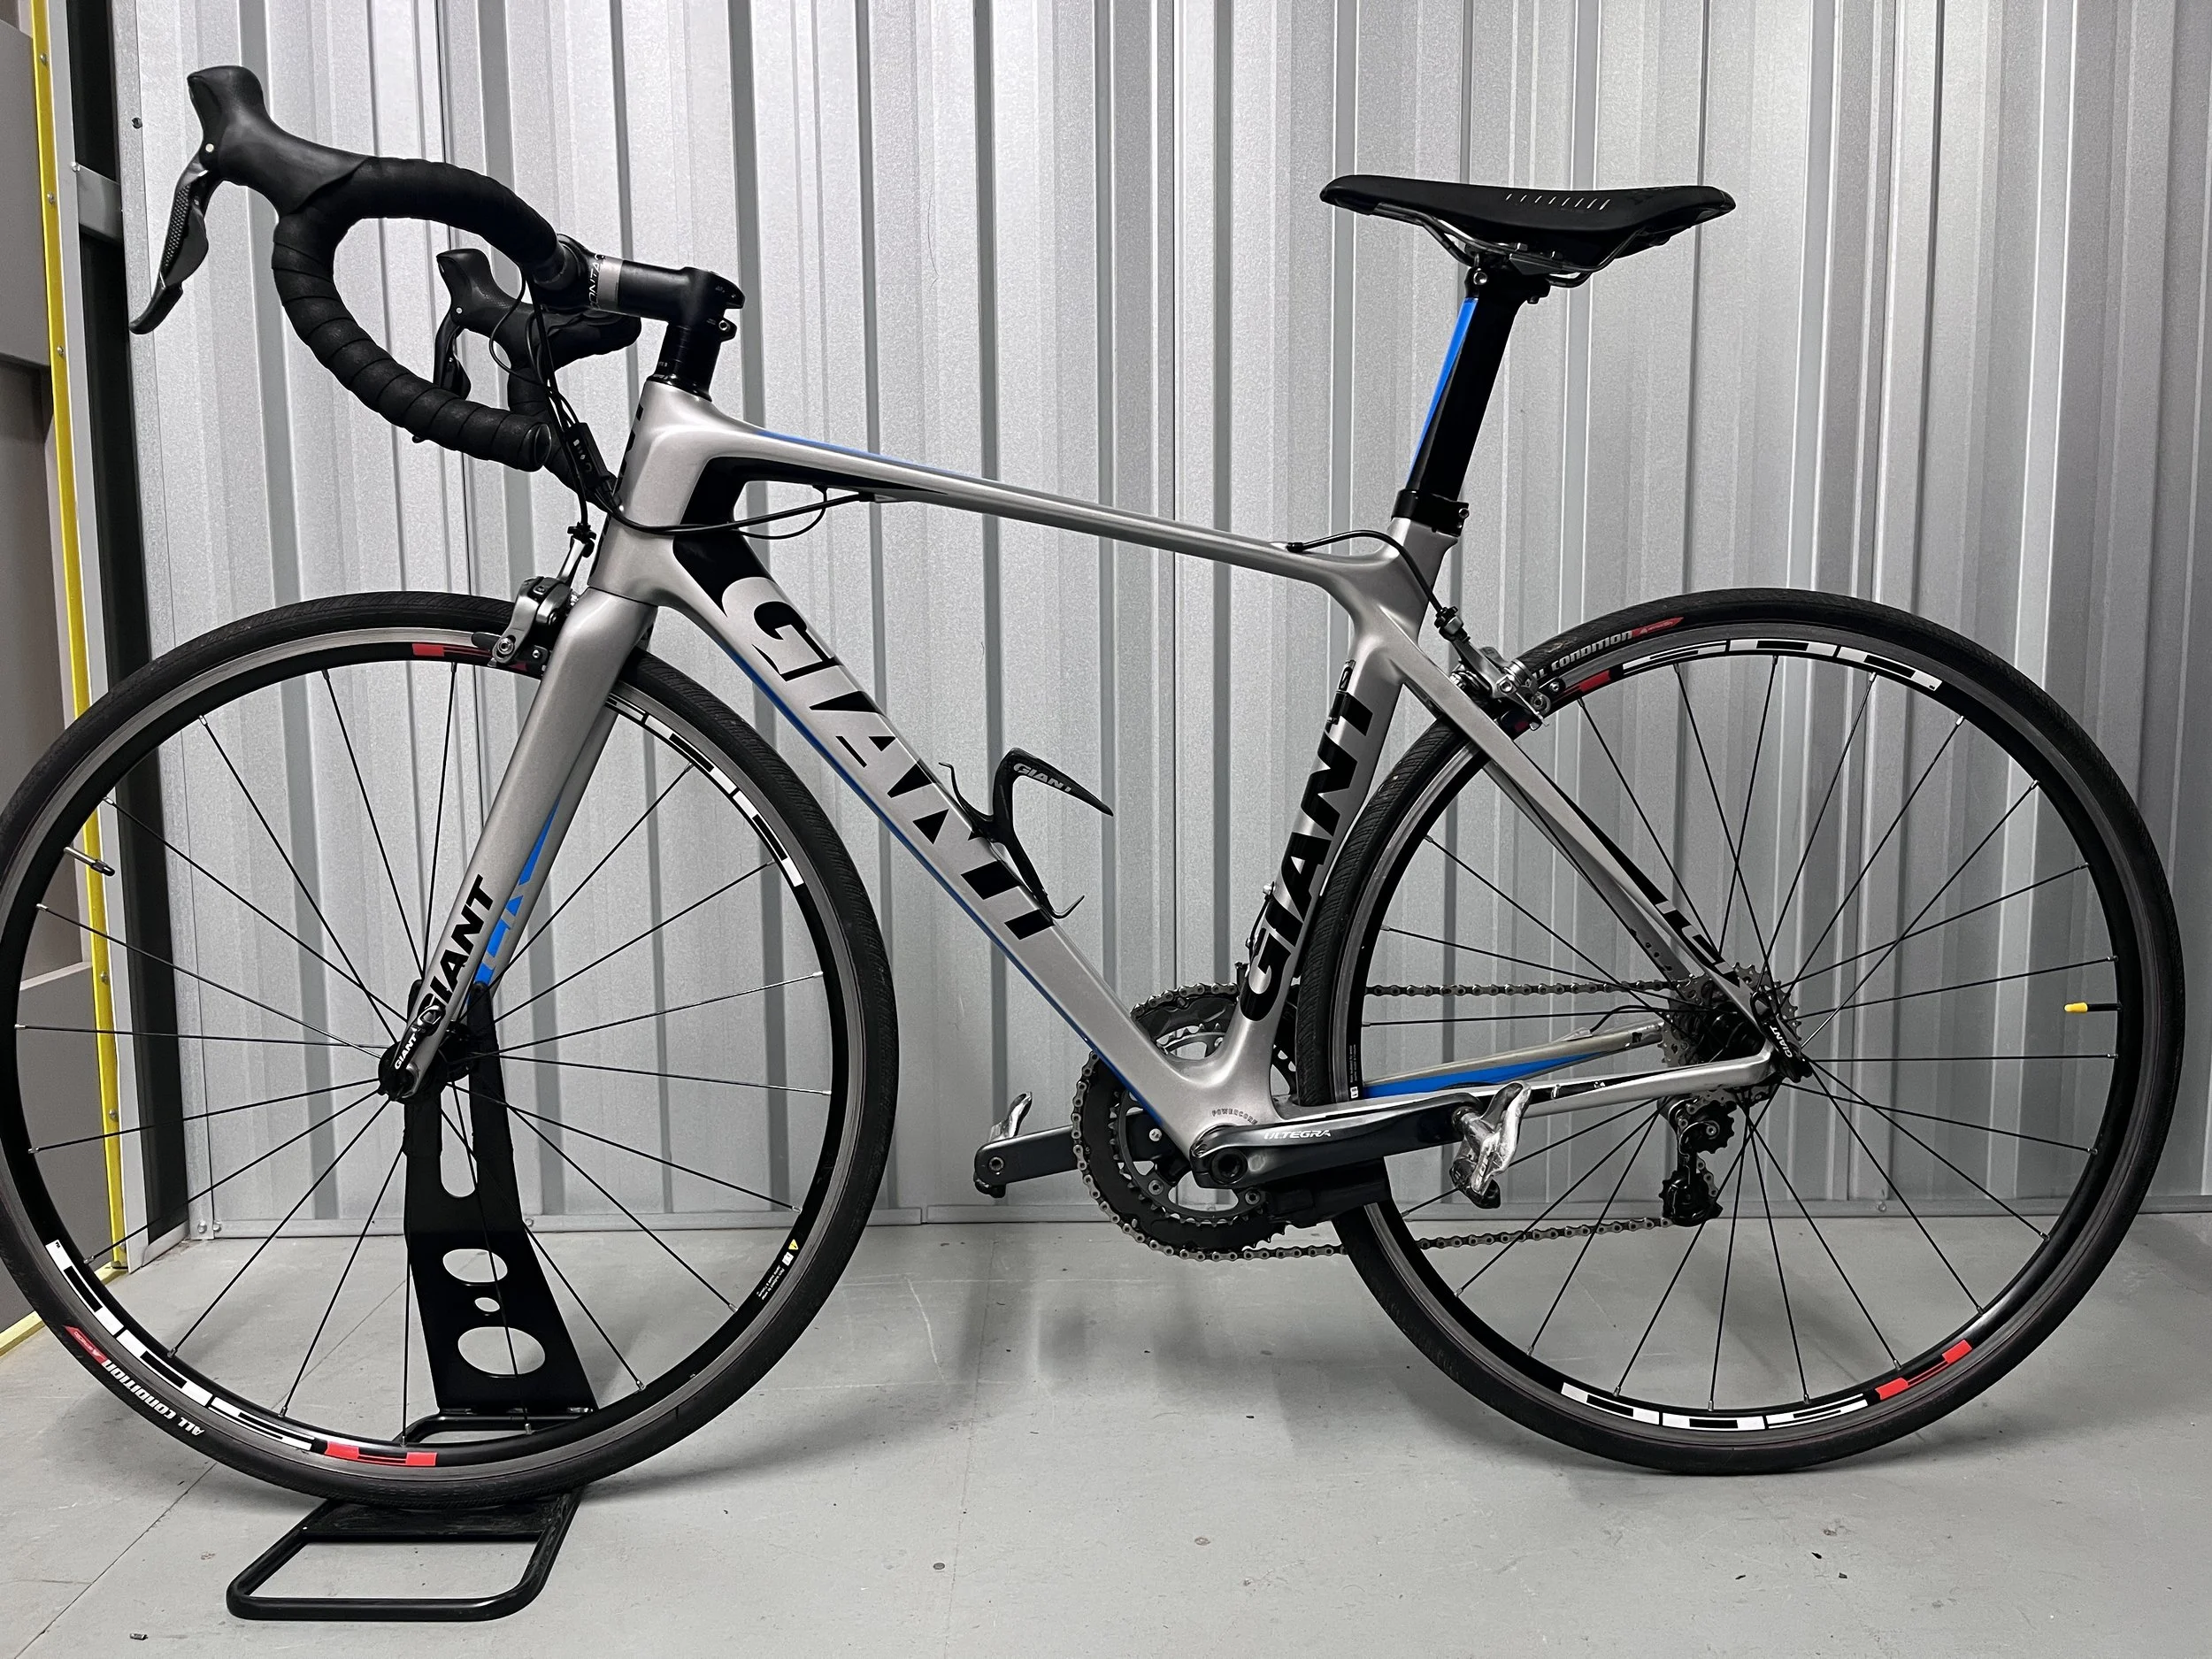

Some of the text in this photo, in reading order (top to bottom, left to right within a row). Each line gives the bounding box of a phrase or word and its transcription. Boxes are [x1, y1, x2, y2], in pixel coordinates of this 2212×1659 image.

[1240, 690, 1373, 1021] GIANT
[394, 1033, 417, 1070] GIANT
[1770, 1025, 1793, 1058] GIANT
[1263, 1129, 1332, 1140] ULTEGRA
[101, 1359, 205, 1436] ALL CONDITION
